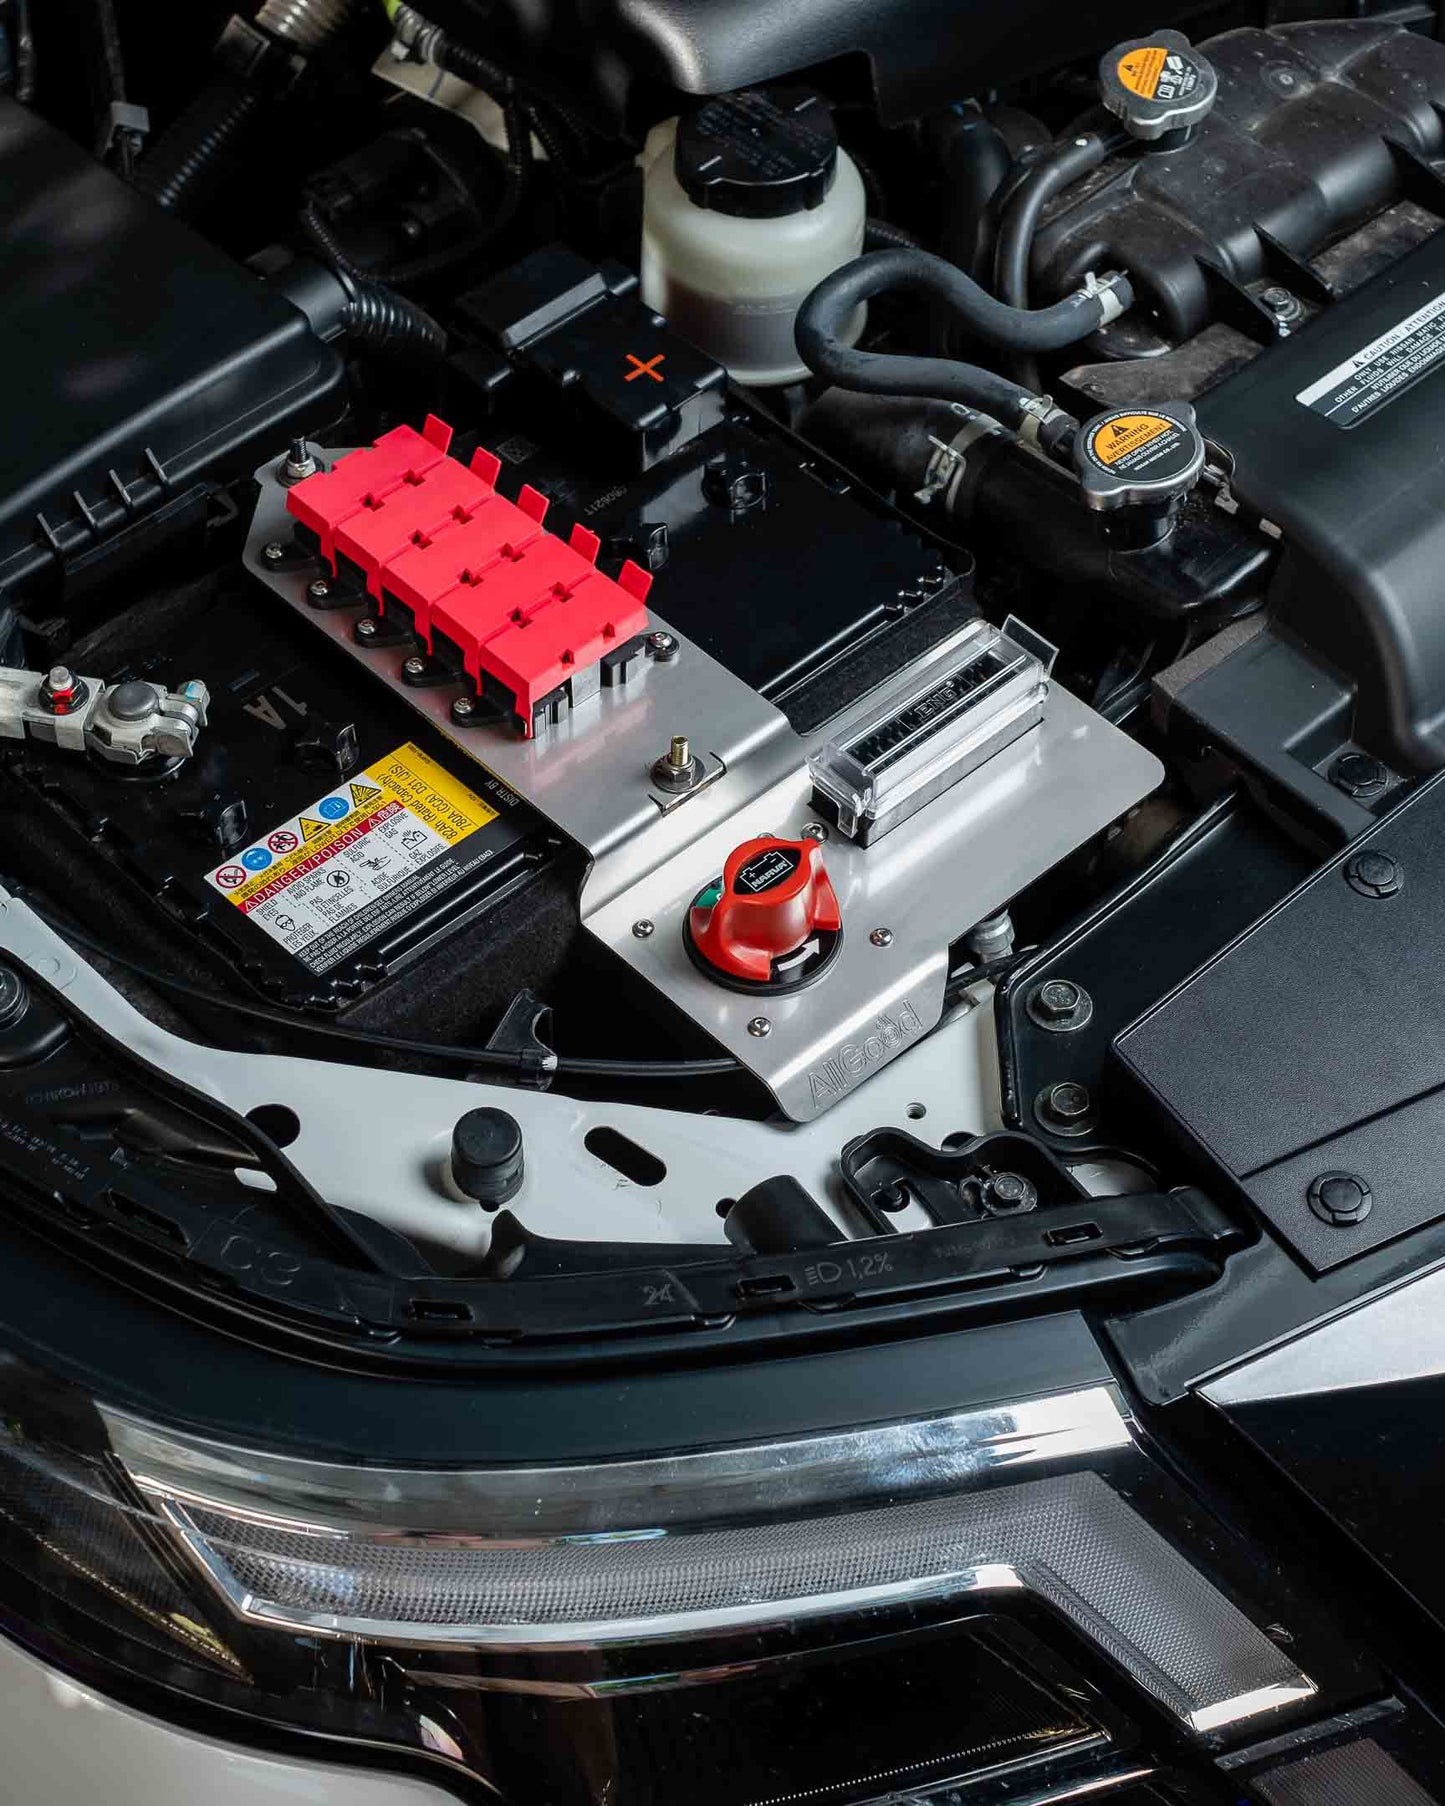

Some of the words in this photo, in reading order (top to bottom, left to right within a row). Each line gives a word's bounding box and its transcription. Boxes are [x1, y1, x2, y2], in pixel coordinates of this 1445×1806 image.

[1354, 367, 1372, 380] ONLY
[1375, 355, 1389, 366] USE
[1390, 337, 1415, 356] NISSAN
[1416, 322, 1436, 337] MATIC
[1364, 335, 1401, 359] CAUTION
[1399, 360, 1413, 373] QUE
[1412, 353, 1422, 362] DU
[1420, 339, 1442, 356] LIQUIDE
[1335, 386, 1357, 403] OTHER
[1360, 368, 1384, 385] FLUIDS
[1387, 355, 1404, 366] WILL
[1406, 333, 1433, 353] DAMAGE
[1106, 424, 1149, 449] WARNING
[1106, 423, 1167, 461] AVERTISSEMENT
[387, 762, 412, 782] (JIS)
[374, 770, 415, 804] Capacity)
[406, 777, 427, 794] D31
[484, 779, 499, 789] BY
[407, 798, 438, 824] (Rated
[423, 791, 452, 815] (CCA)
[377, 811, 408, 833] EXPLOSIVE
[432, 818, 458, 840] 82Ah
[445, 809, 472, 831] 780A
[383, 827, 399, 839] GAS
[341, 836, 371, 857] SULFURIC
[348, 850, 365, 863] ACID
[407, 848, 423, 859] GAZ
[252, 826, 364, 903] DANGER/POISON
[748, 860, 789, 888] NARVA
[285, 880, 306, 895] AVOID
[302, 866, 326, 884] SPARKS
[292, 888, 308, 900] AND
[304, 877, 325, 892] FLAME
[369, 871, 390, 886] ACIDE
[375, 865, 413, 892] SULFURIQUE
[255, 898, 278, 915] SHIELD
[308, 895, 323, 906] PAS
[321, 906, 336, 917] PAS
[332, 901, 344, 910] DE
[261, 908, 279, 921] EYES
[296, 946, 312, 958] KEEP
[307, 940, 321, 950] OUT
[317, 936, 327, 944] OF
[323, 930, 336, 940] THE
[331, 920, 350, 934] REACH
[398, 873, 420, 888] MANUAL
[328, 902, 358, 924] FLAMMES
[281, 922, 313, 944] PROTEGER
[288, 939, 303, 950] LES
[807, 998, 924, 1110] AllGood
[845, 1252, 894, 1282] 1,2%
